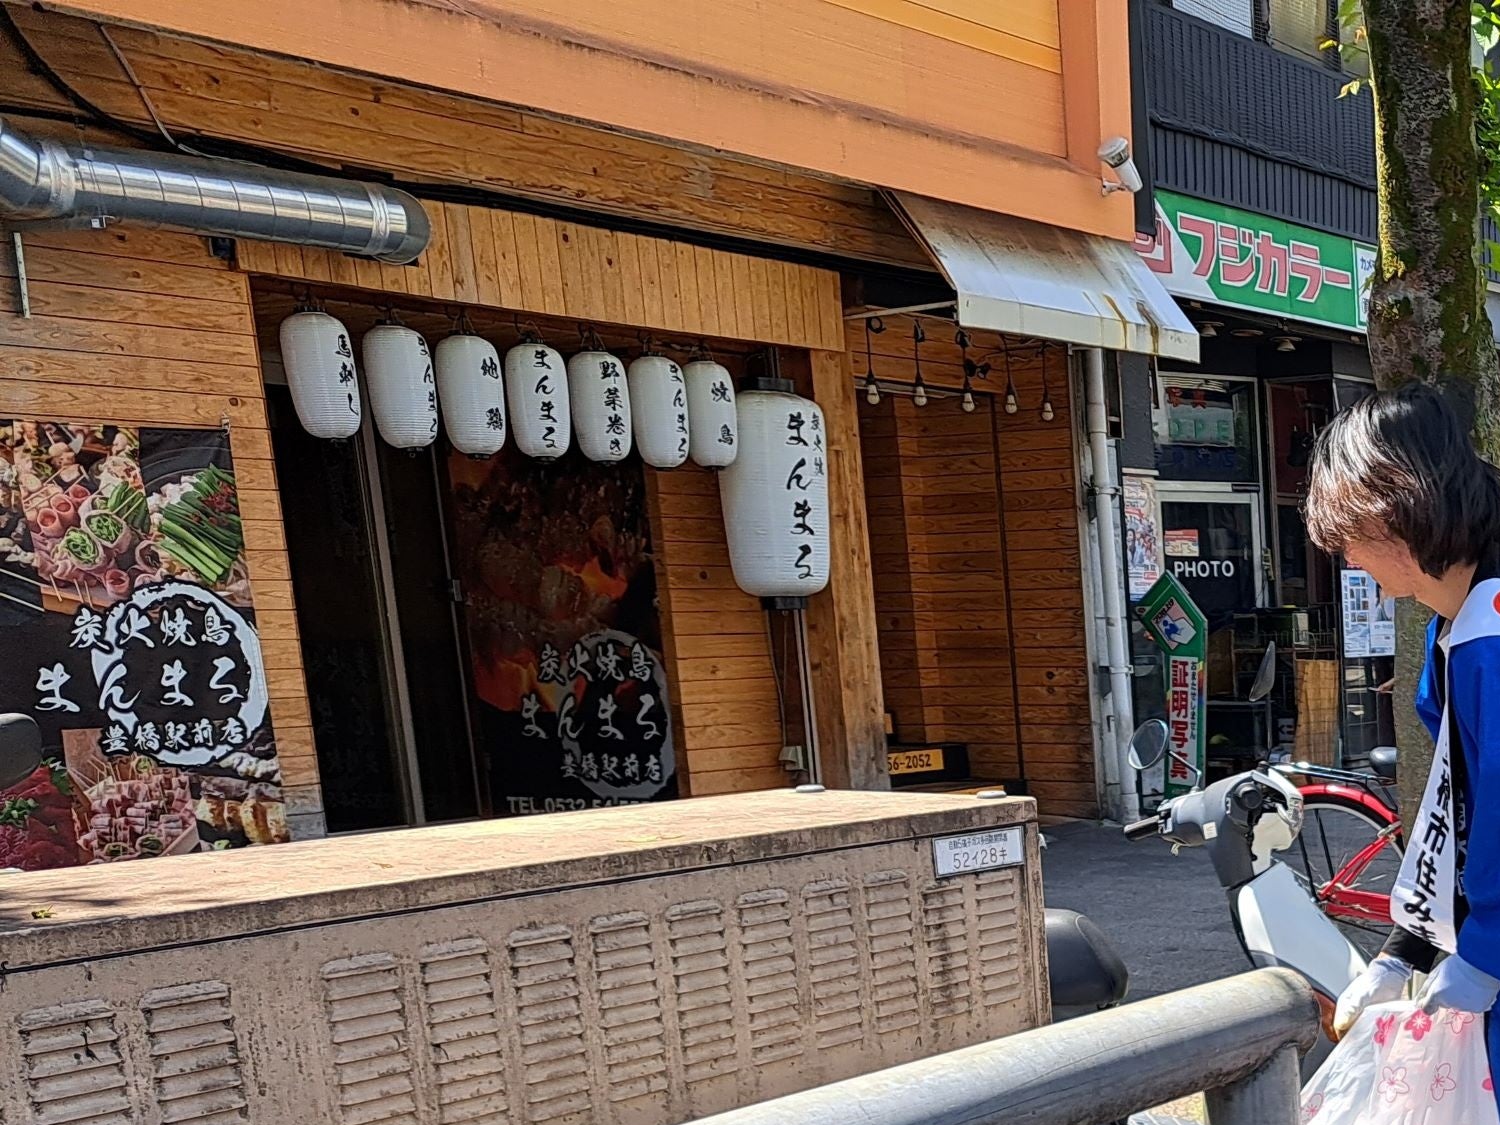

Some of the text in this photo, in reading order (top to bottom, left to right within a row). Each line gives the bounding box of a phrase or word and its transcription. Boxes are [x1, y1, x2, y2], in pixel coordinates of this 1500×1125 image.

[1177, 211, 1352, 303] フジカラー
[335, 333, 359, 416] 馬刺し
[533, 349, 559, 449] まんまる
[599, 360, 627, 457] 野菜巻き
[668, 363, 688, 459] まんまる
[710, 381, 735, 446] 焼鳥
[785, 411, 815, 580] まんまる
[1173, 559, 1235, 578] PHOTO
[69, 605, 235, 651] 炭火焼鳥
[34, 656, 246, 713] まんまる
[538, 642, 653, 684] 炭火焼鳥
[100, 716, 246, 754] 豊橋駅前店
[521, 692, 663, 741] まんまる
[1170, 659, 1190, 781] 証明写真
[560, 752, 662, 782] 豊橋駅前店
[888, 753, 932, 771] 56-2052
